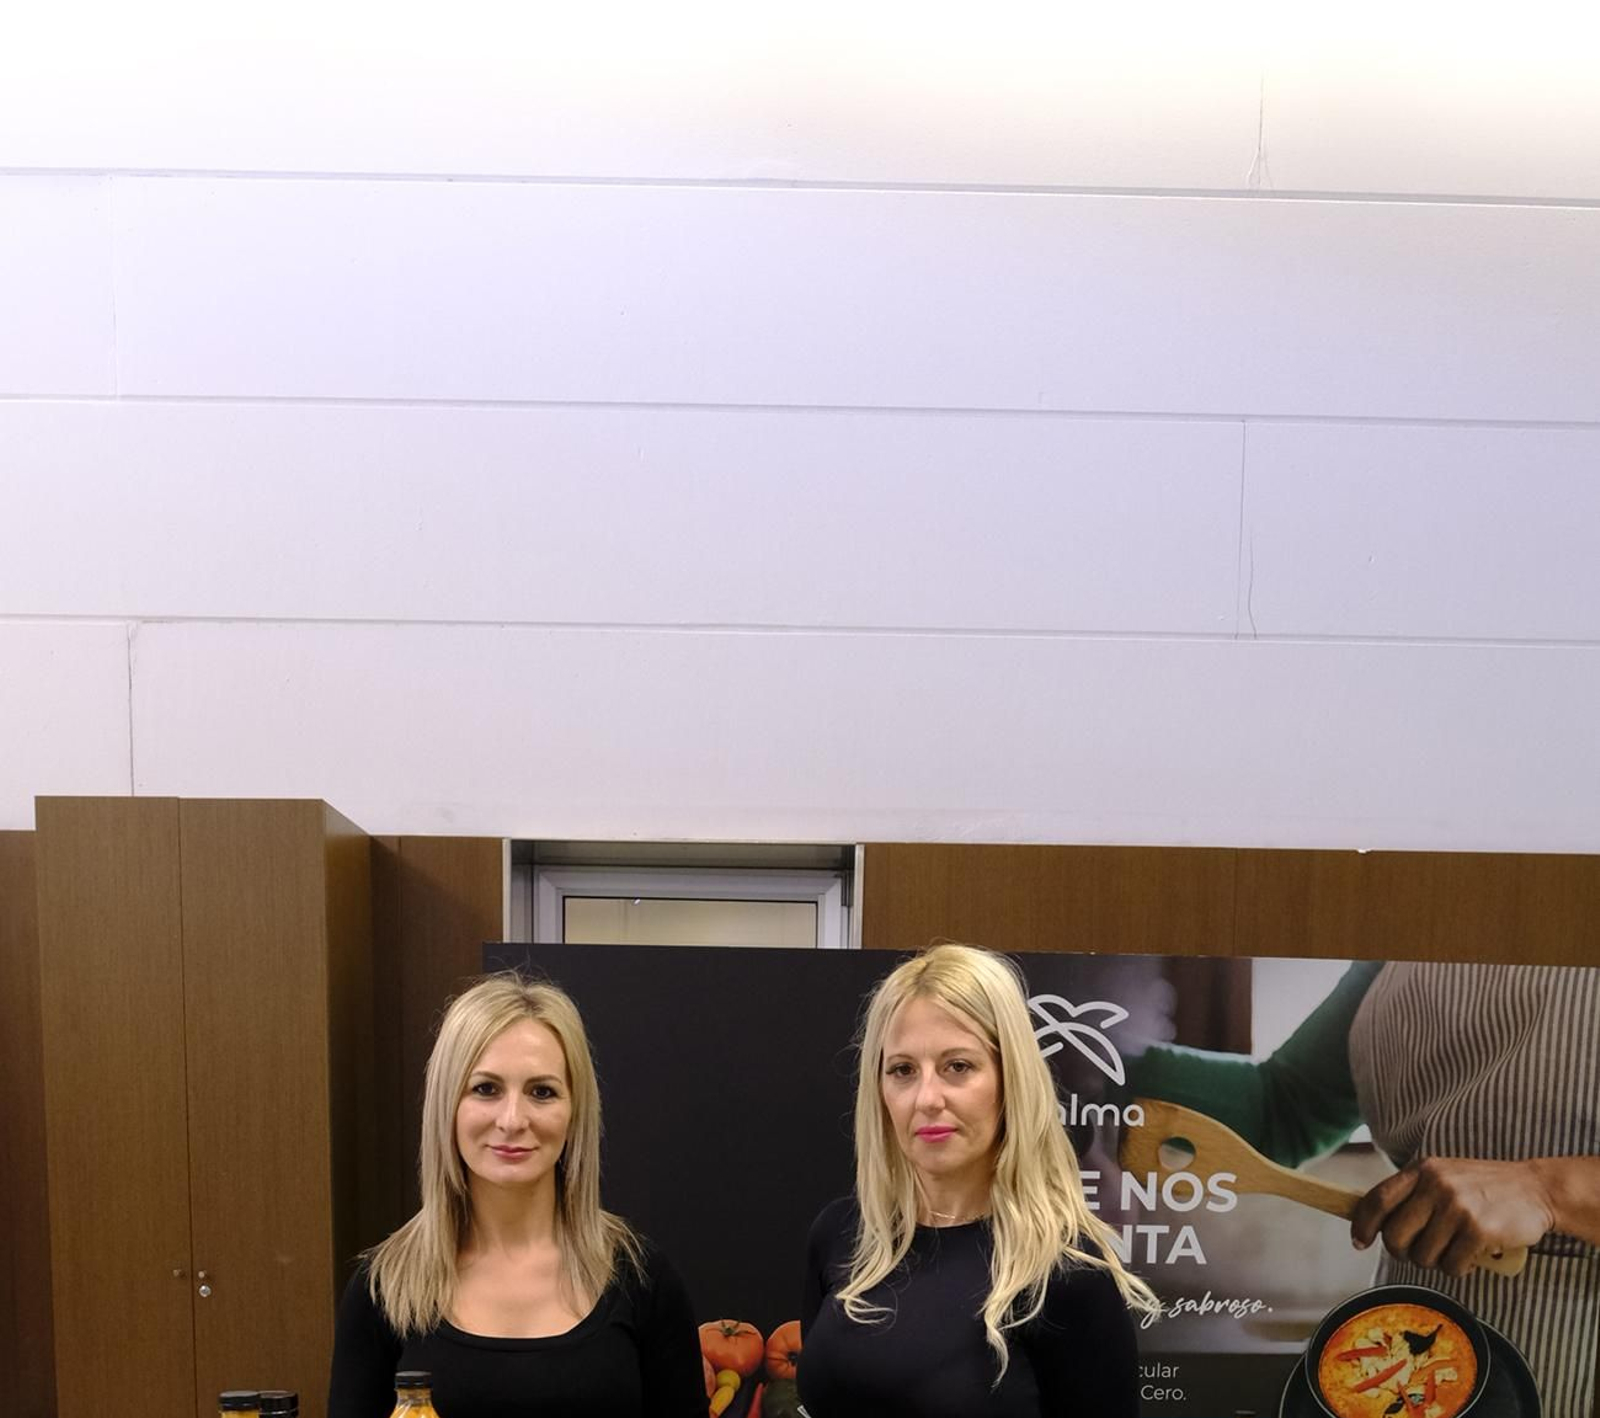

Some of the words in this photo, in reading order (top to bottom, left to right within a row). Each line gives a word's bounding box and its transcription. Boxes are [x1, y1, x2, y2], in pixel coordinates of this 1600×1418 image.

[1121, 1171, 1239, 1213] NOS
[1168, 1291, 1274, 1319] sabroso.
[1140, 1385, 1187, 1401] Cero.
